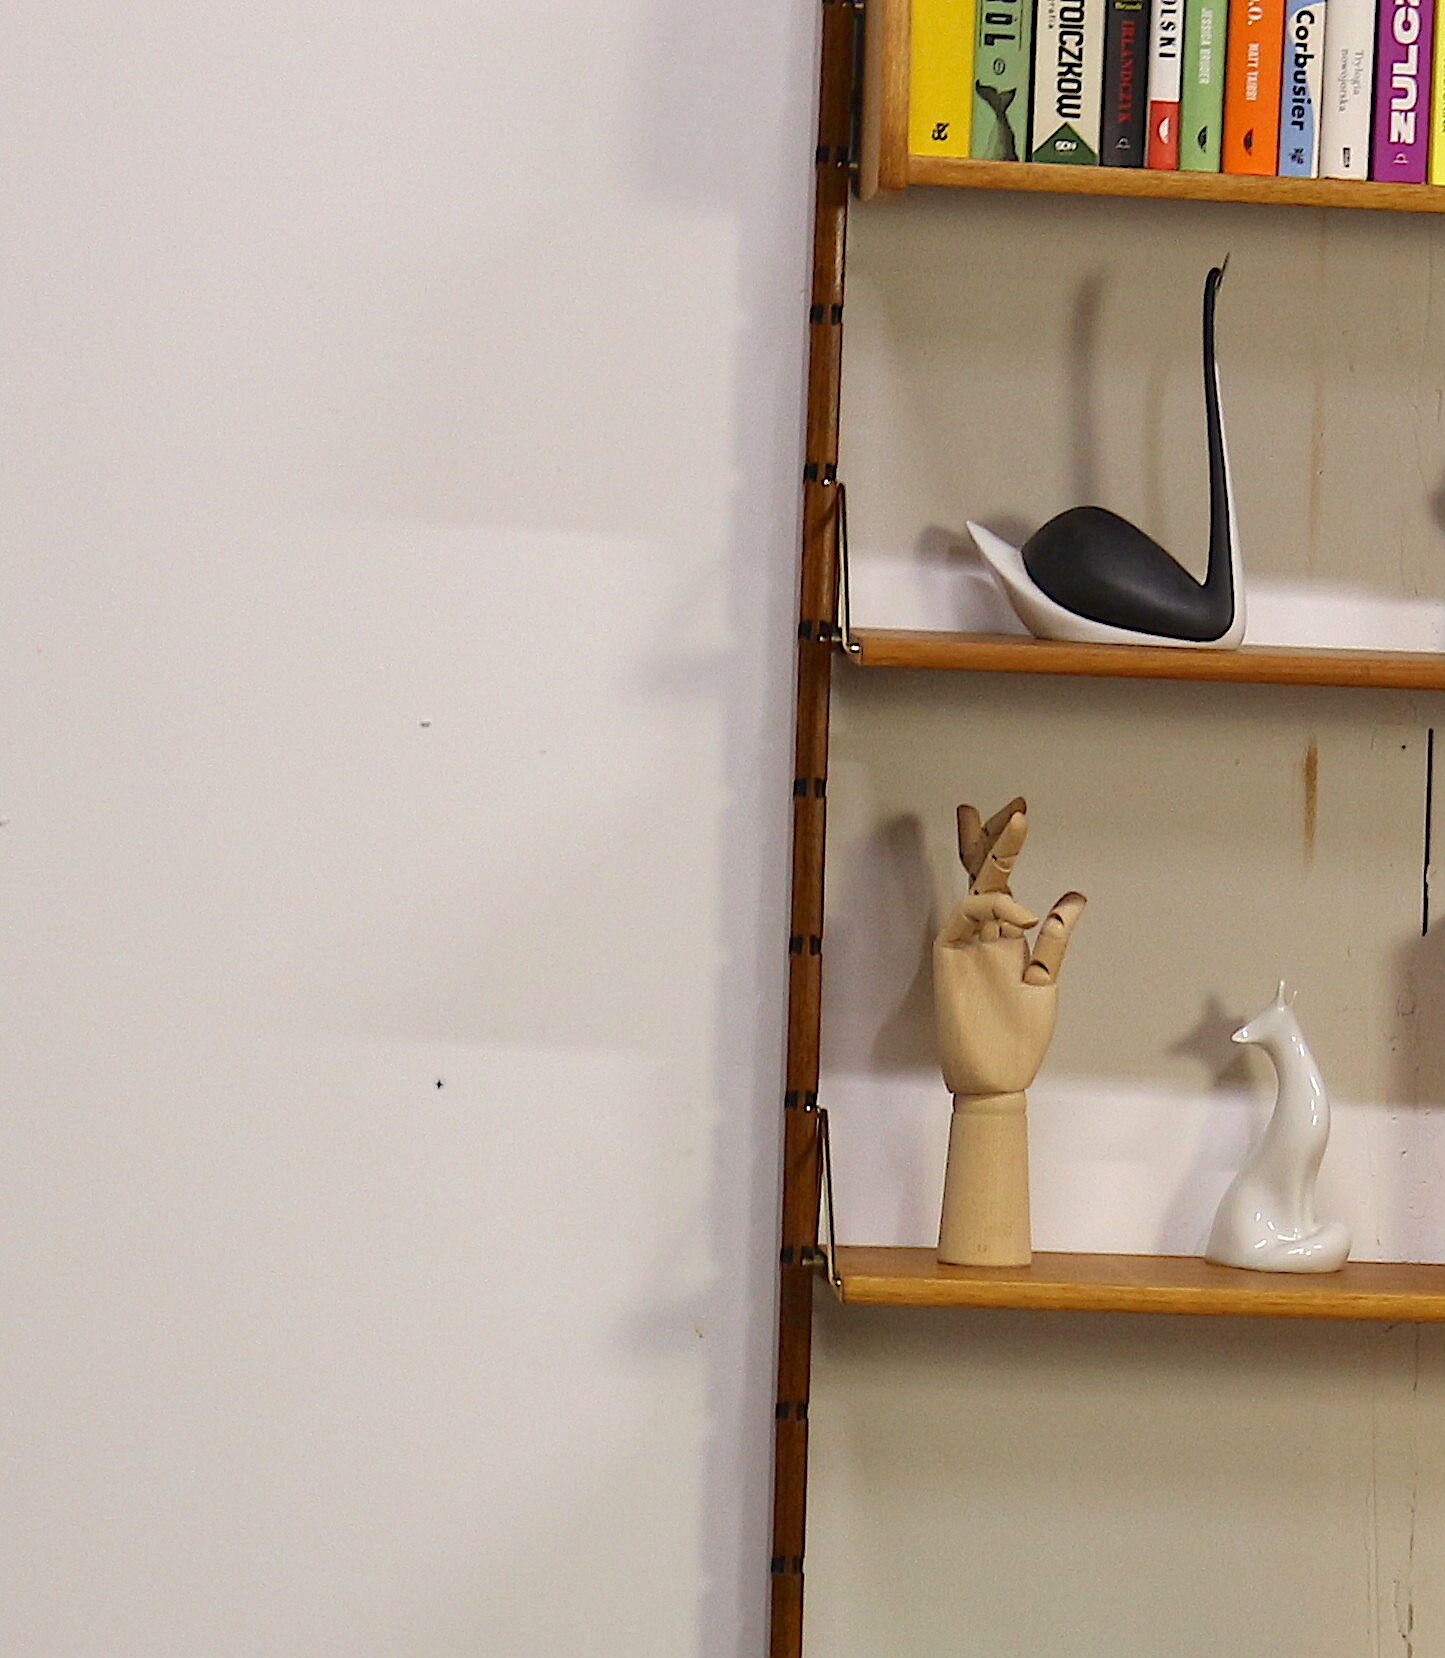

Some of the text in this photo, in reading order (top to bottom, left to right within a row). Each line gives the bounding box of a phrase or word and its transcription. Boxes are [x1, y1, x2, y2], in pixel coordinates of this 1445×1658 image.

[985, 0, 1018, 46] ÓL
[1290, 10, 1315, 131] Corbusier
[1337, 49, 1351, 112] nowojorska
[1351, 50, 1365, 95] Trylogia
[1388, 0, 1421, 144] ZULC
